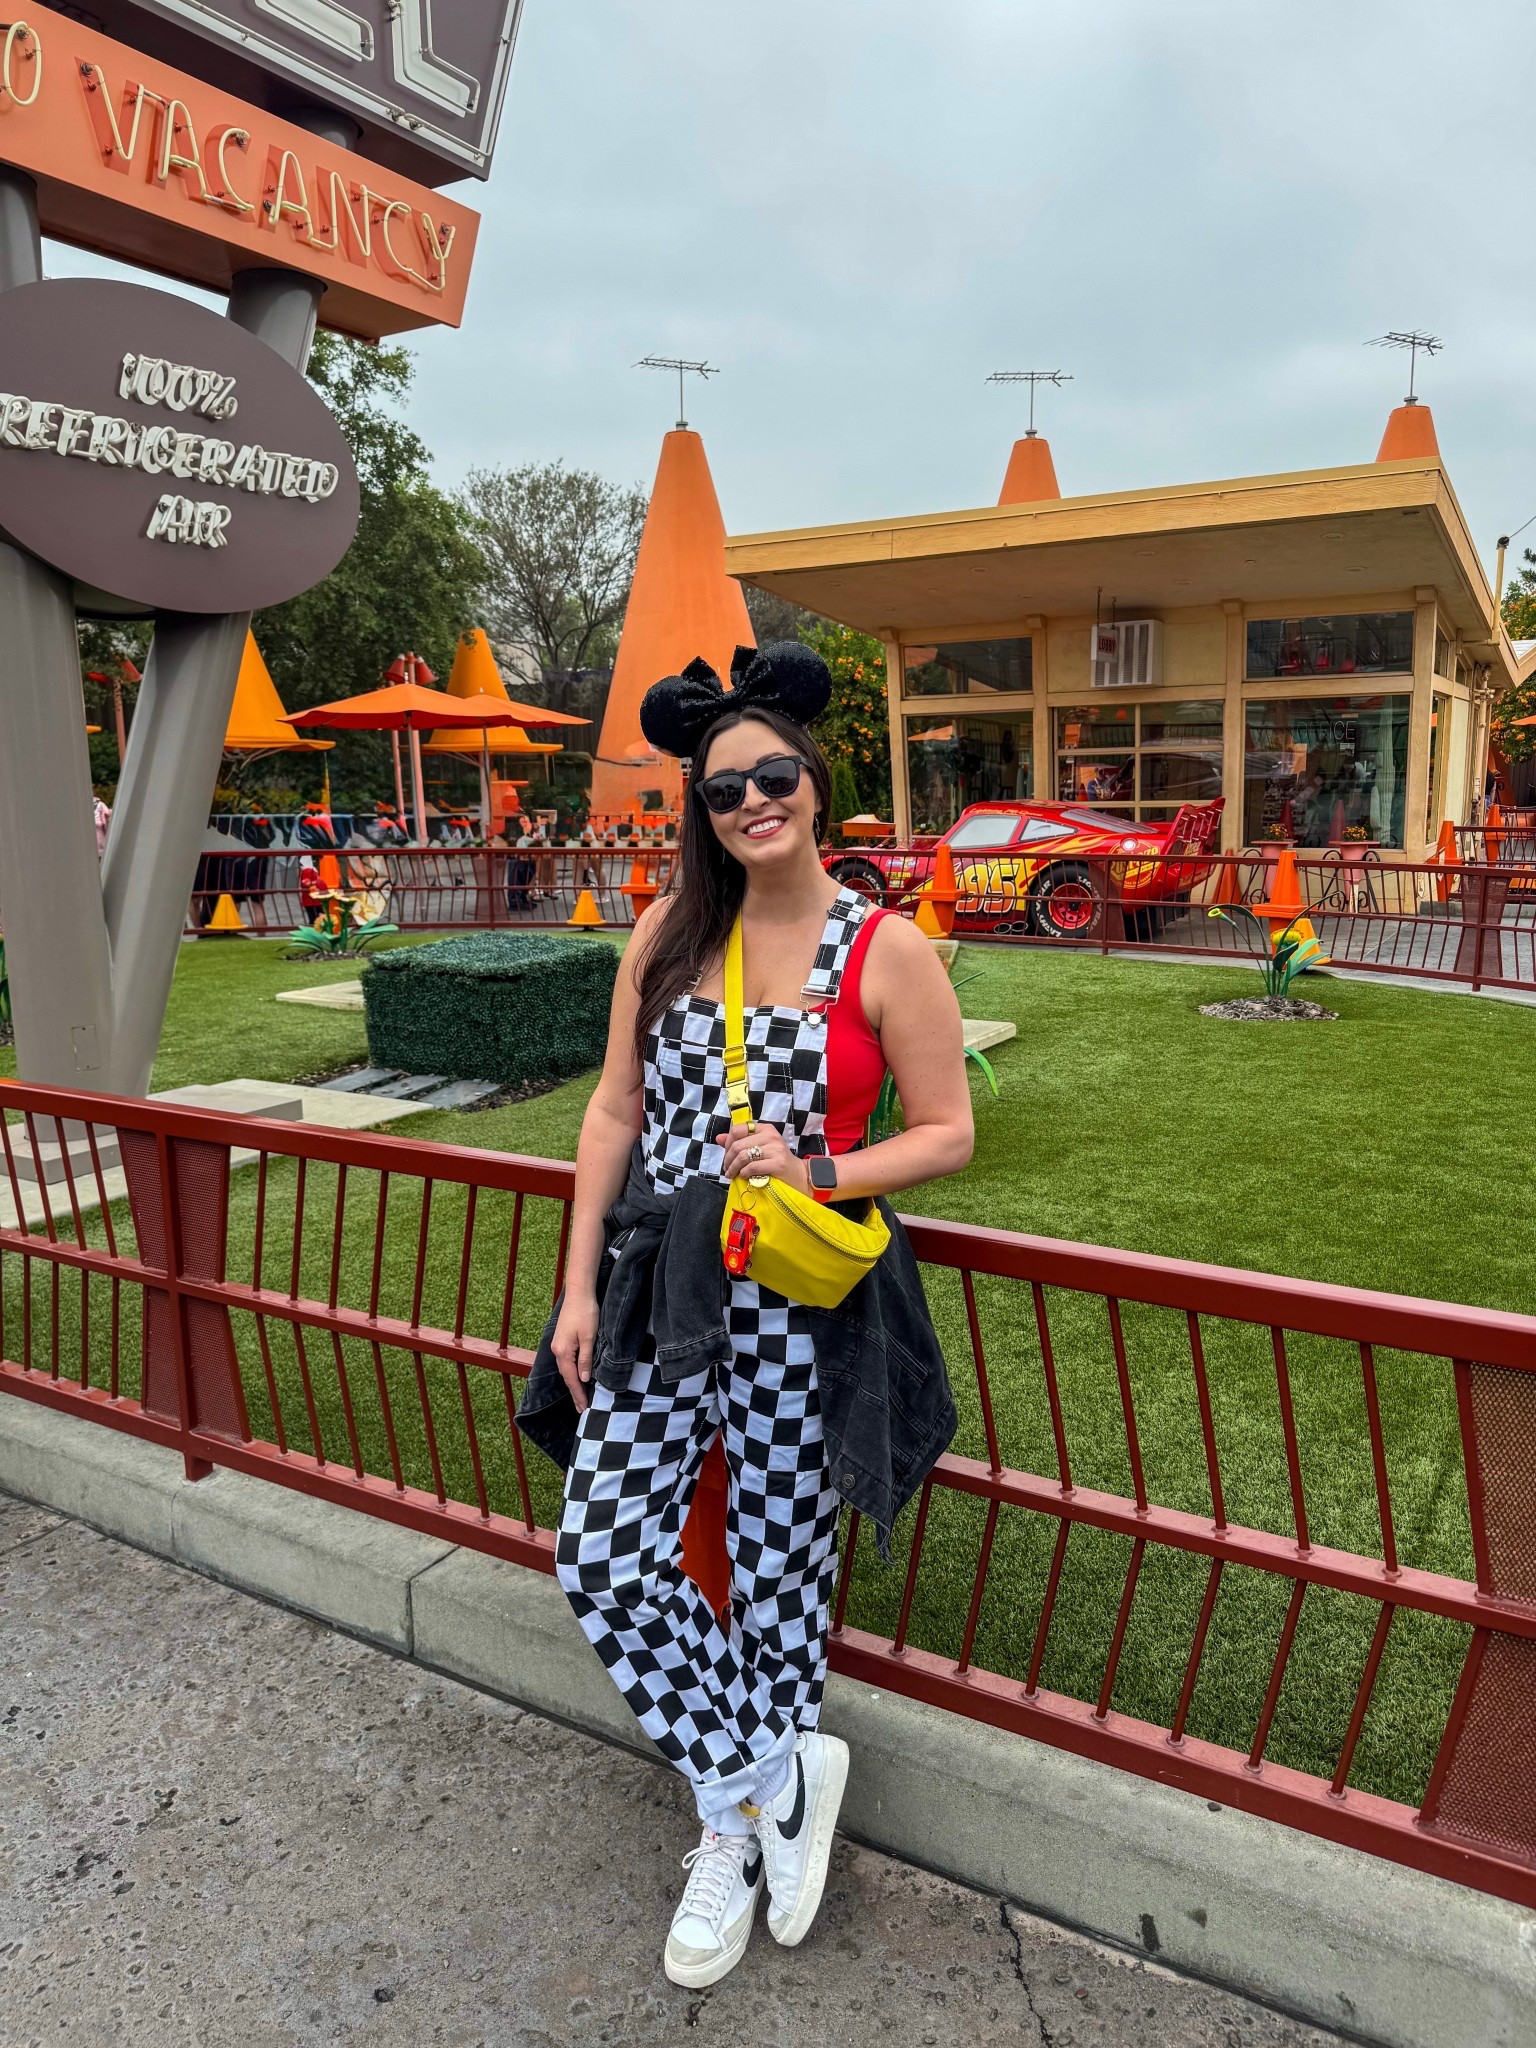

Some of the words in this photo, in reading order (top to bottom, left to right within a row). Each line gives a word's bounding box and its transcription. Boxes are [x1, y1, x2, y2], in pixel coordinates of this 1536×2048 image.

[254, 0, 480, 117] L
[4, 20, 42, 106] O
[75, 57, 457, 297] VACANCY
[119, 352, 238, 420] 100%
[0, 392, 339, 503] REFRIGERATED
[146, 494, 232, 548] AIR
[1098, 637, 1117, 654] LOBBY
[1297, 720, 1356, 740] OFFICE
[955, 863, 1020, 914] 95
